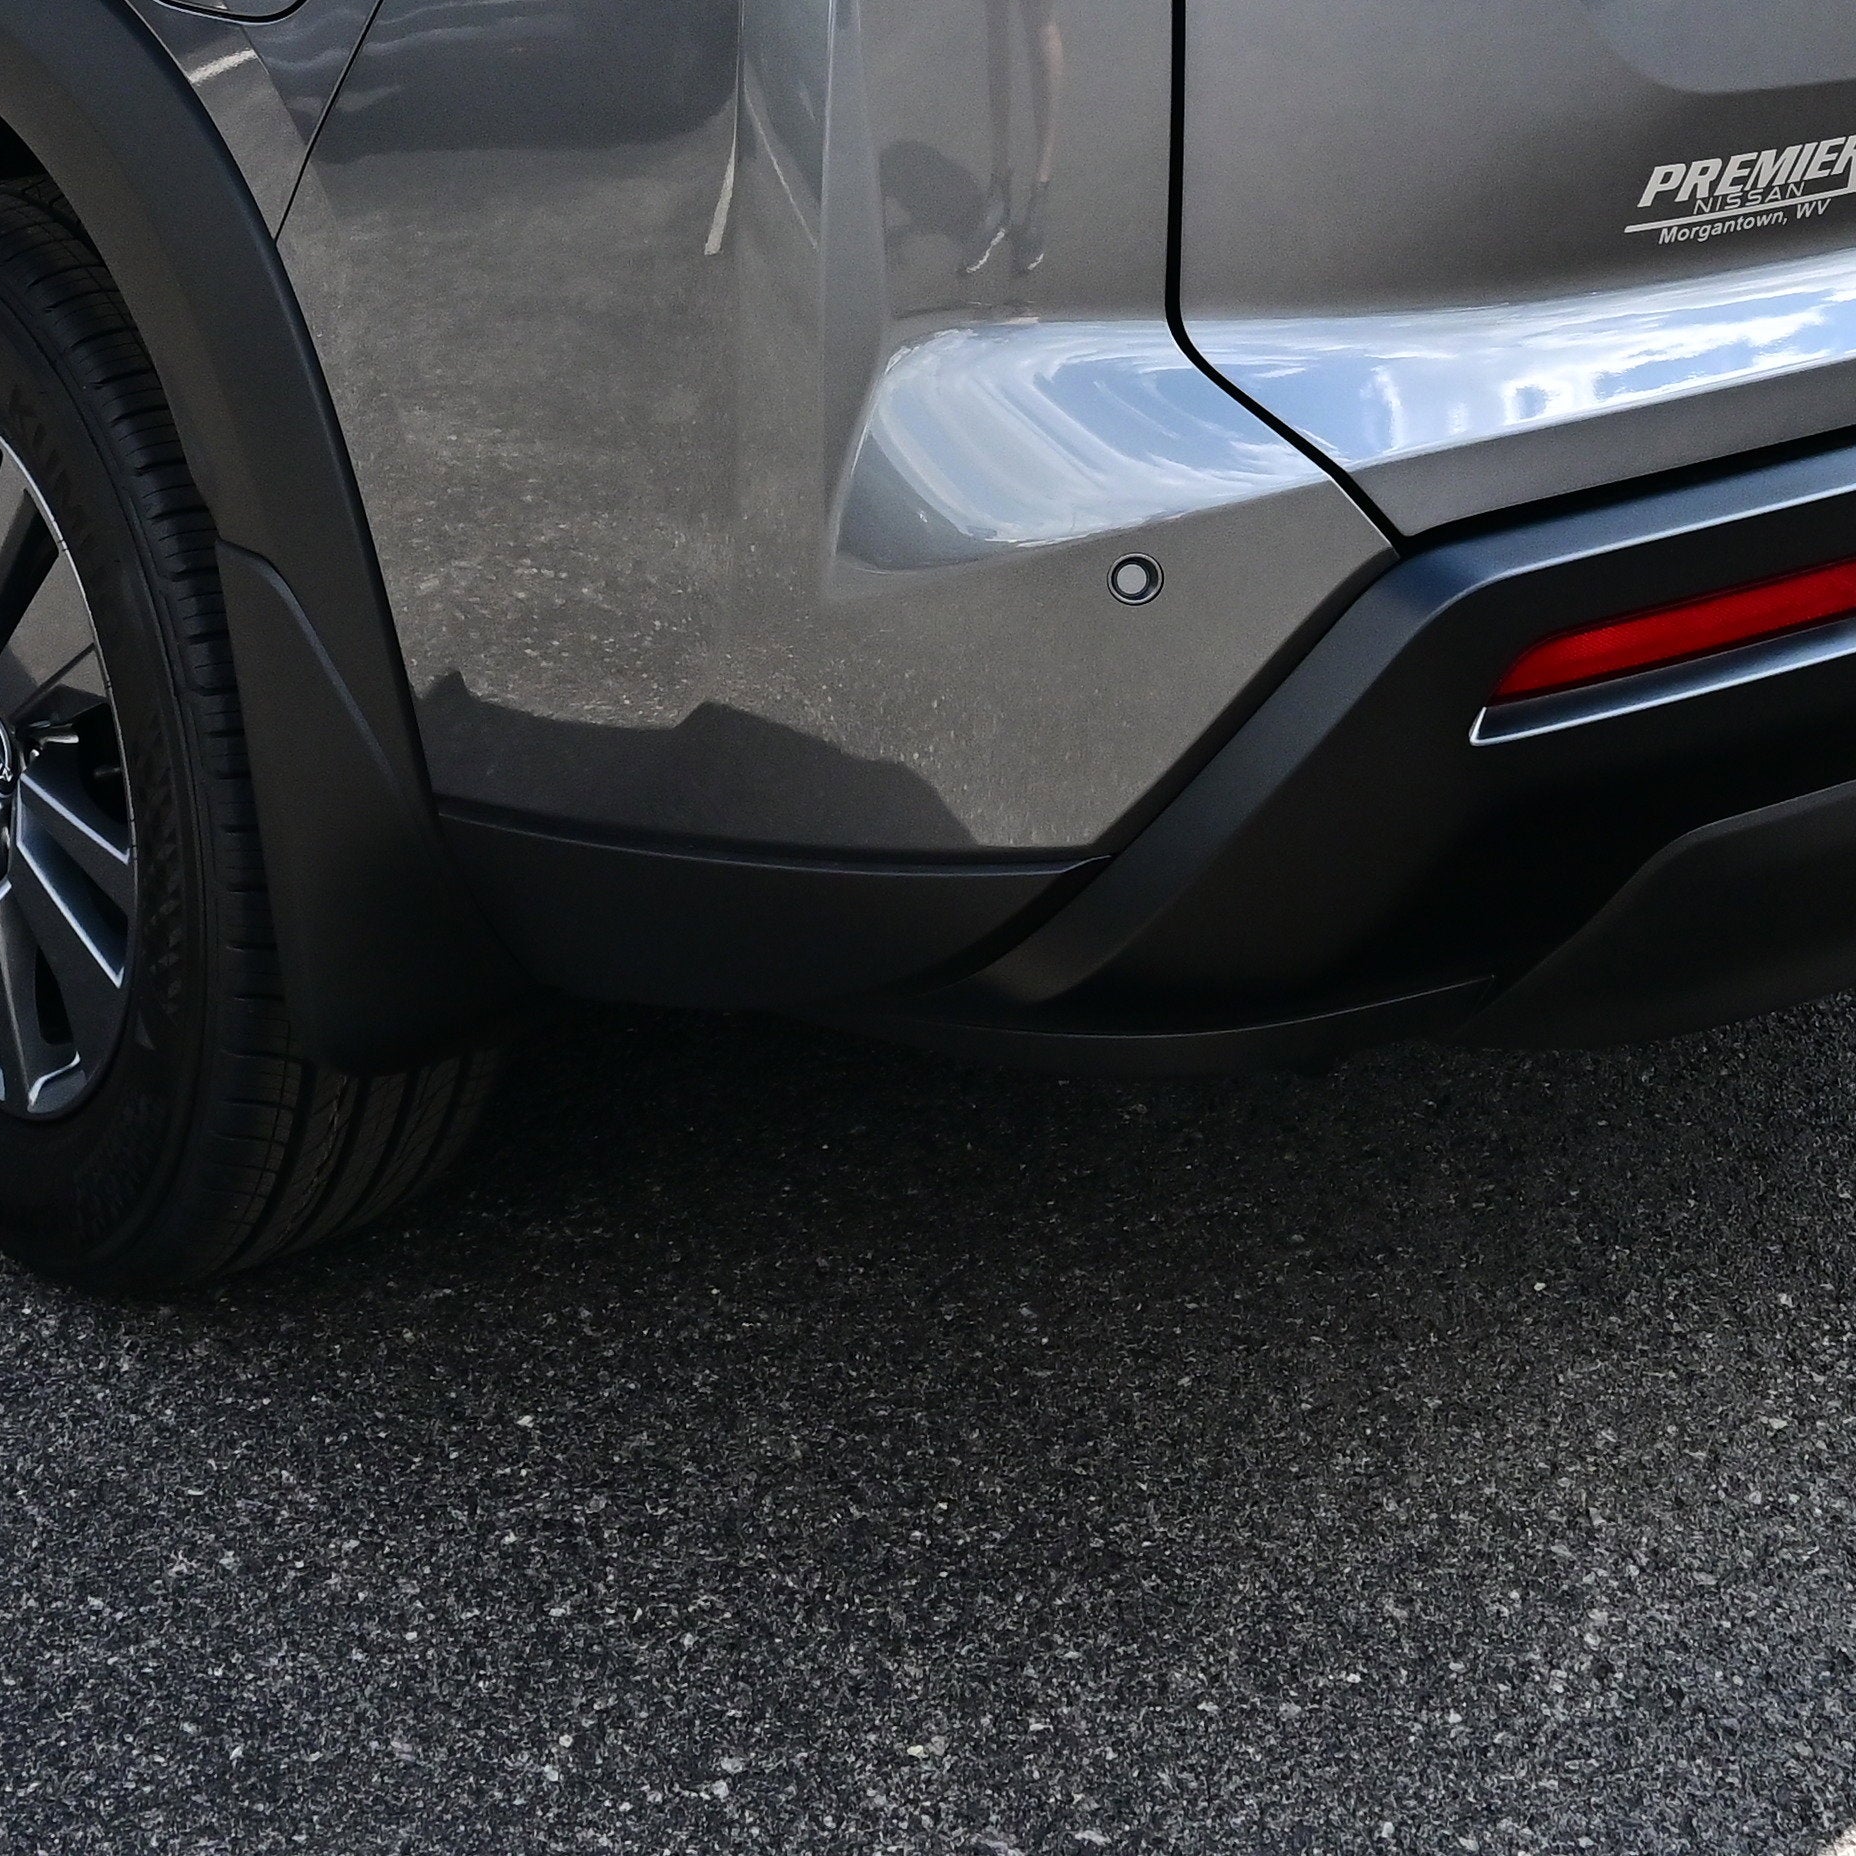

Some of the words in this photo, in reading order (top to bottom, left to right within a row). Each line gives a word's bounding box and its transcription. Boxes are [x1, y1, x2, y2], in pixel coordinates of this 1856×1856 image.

[1693, 180, 1805, 215] NISSAN
[1658, 209, 1789, 245] Morgantown,
[1796, 198, 1832, 220] WV
